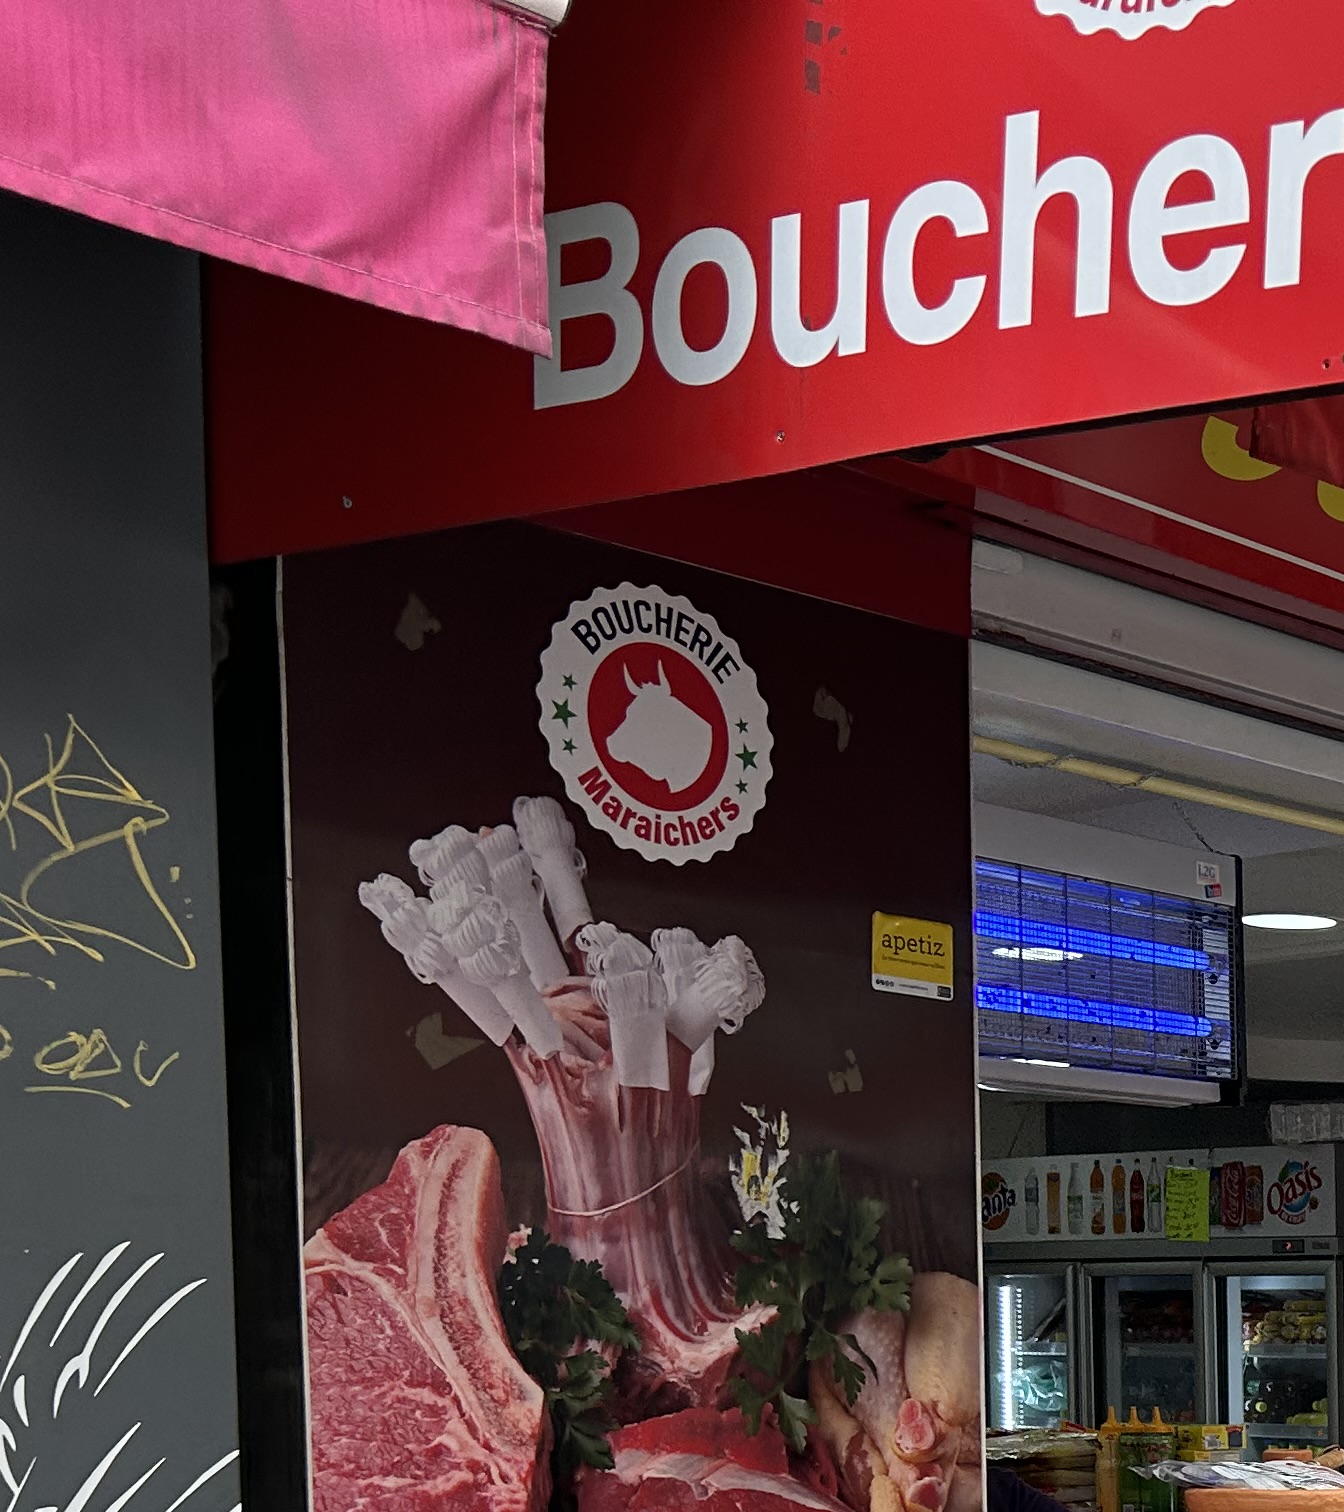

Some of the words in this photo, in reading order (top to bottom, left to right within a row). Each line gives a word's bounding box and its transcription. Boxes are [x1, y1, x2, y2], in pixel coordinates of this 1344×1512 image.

[571, 599, 740, 684] BOUCHERIE
[577, 765, 740, 847] Maraichers
[881, 933, 946, 958] apetiz
[1267, 1160, 1323, 1215] Oasis
